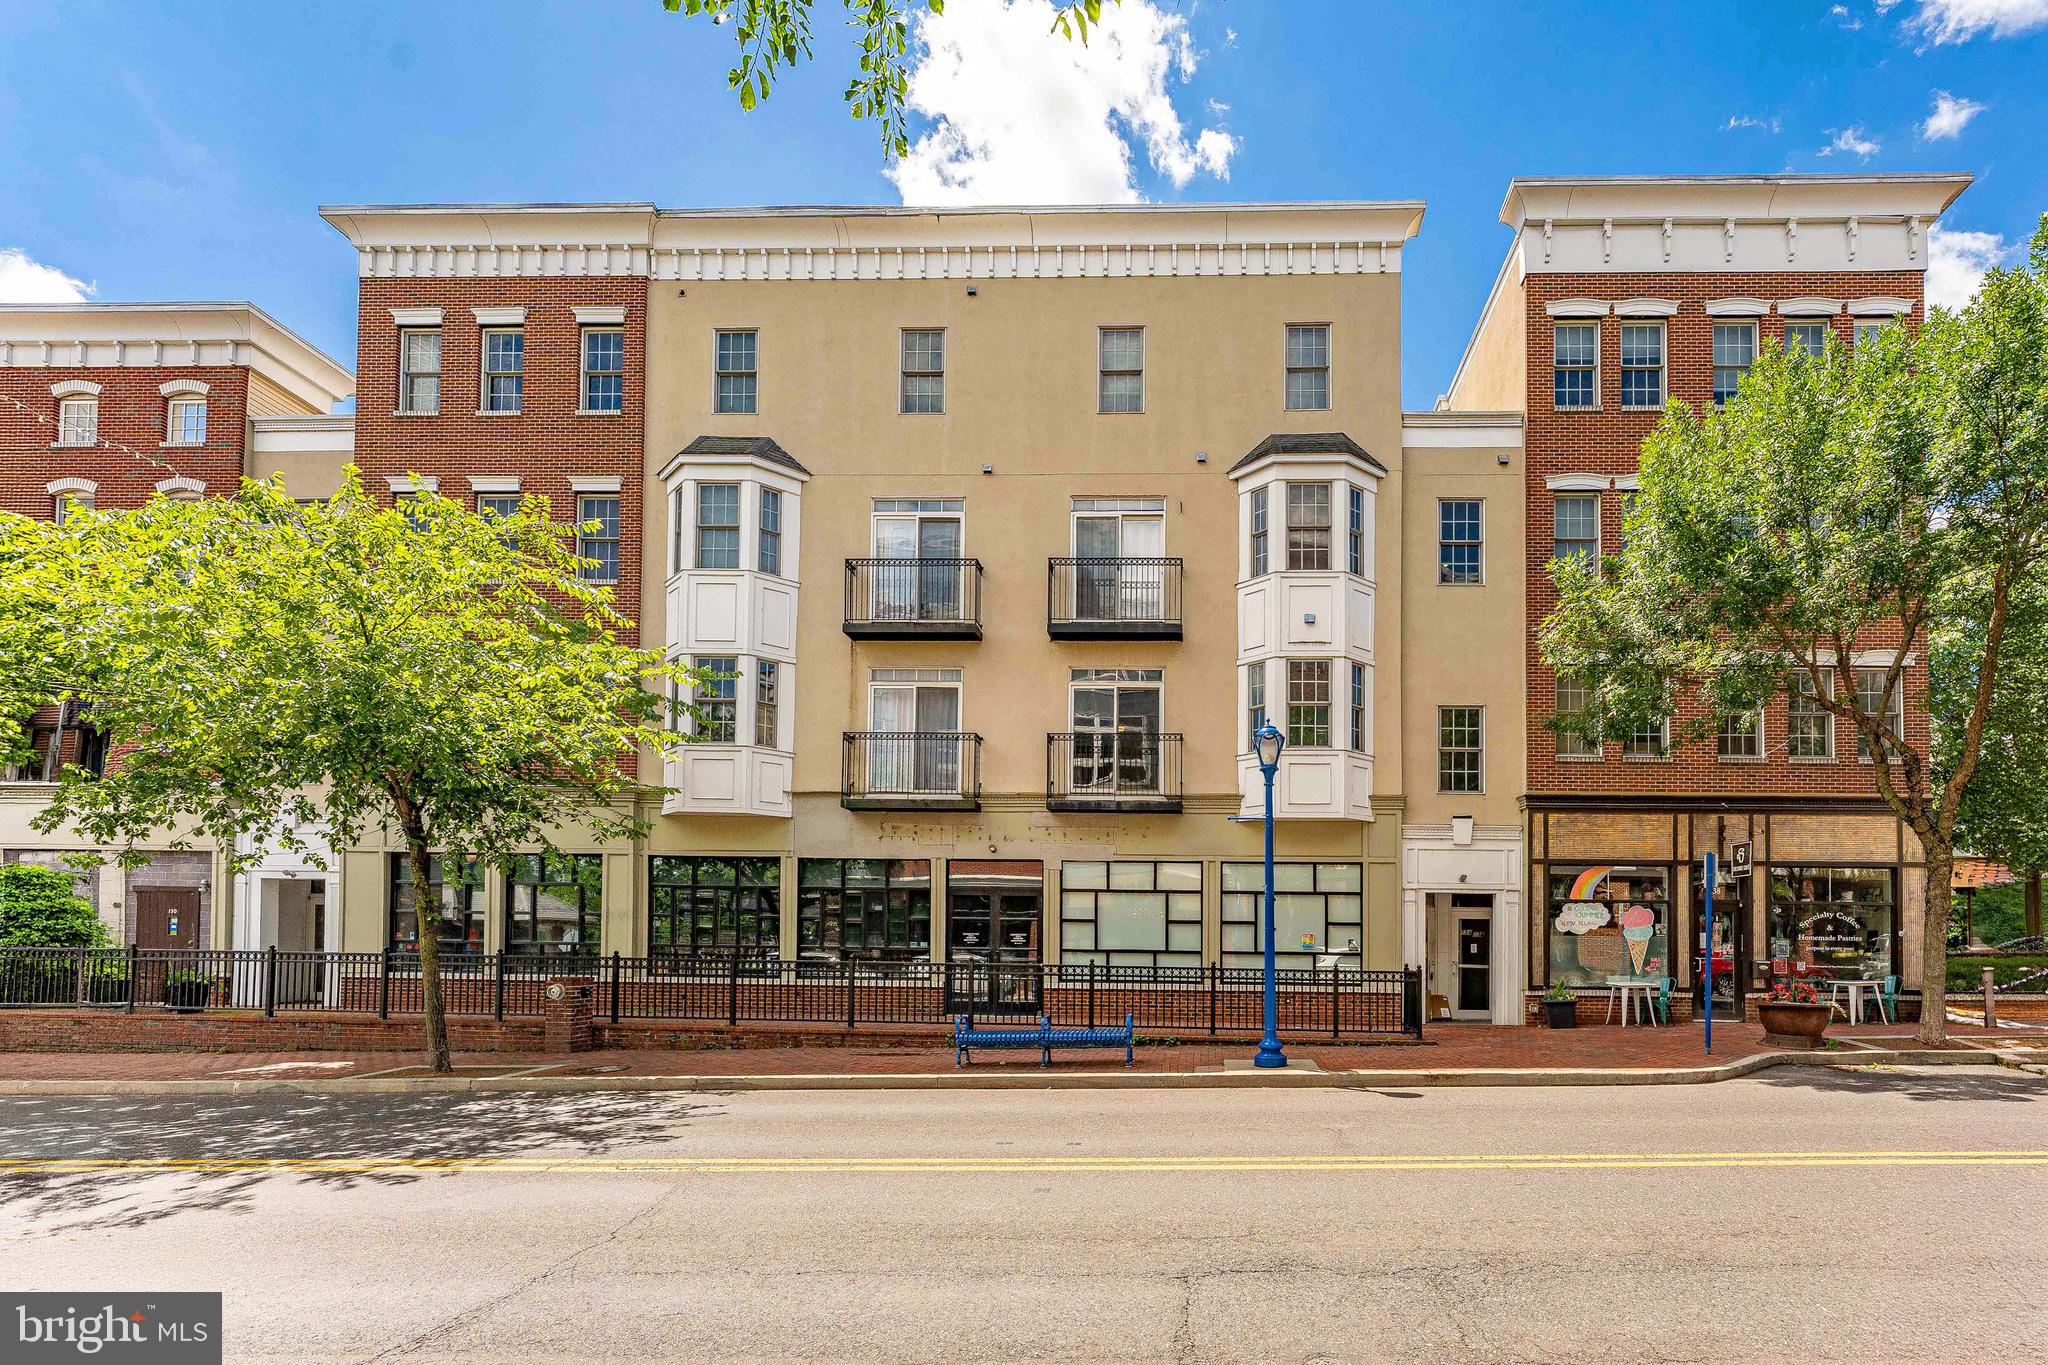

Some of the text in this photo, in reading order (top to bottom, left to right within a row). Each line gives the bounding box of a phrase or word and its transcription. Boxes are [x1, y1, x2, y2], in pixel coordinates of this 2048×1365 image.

[1799, 911, 1861, 930] Specialty Coffee
[1837, 934, 1863, 942] Pastries
